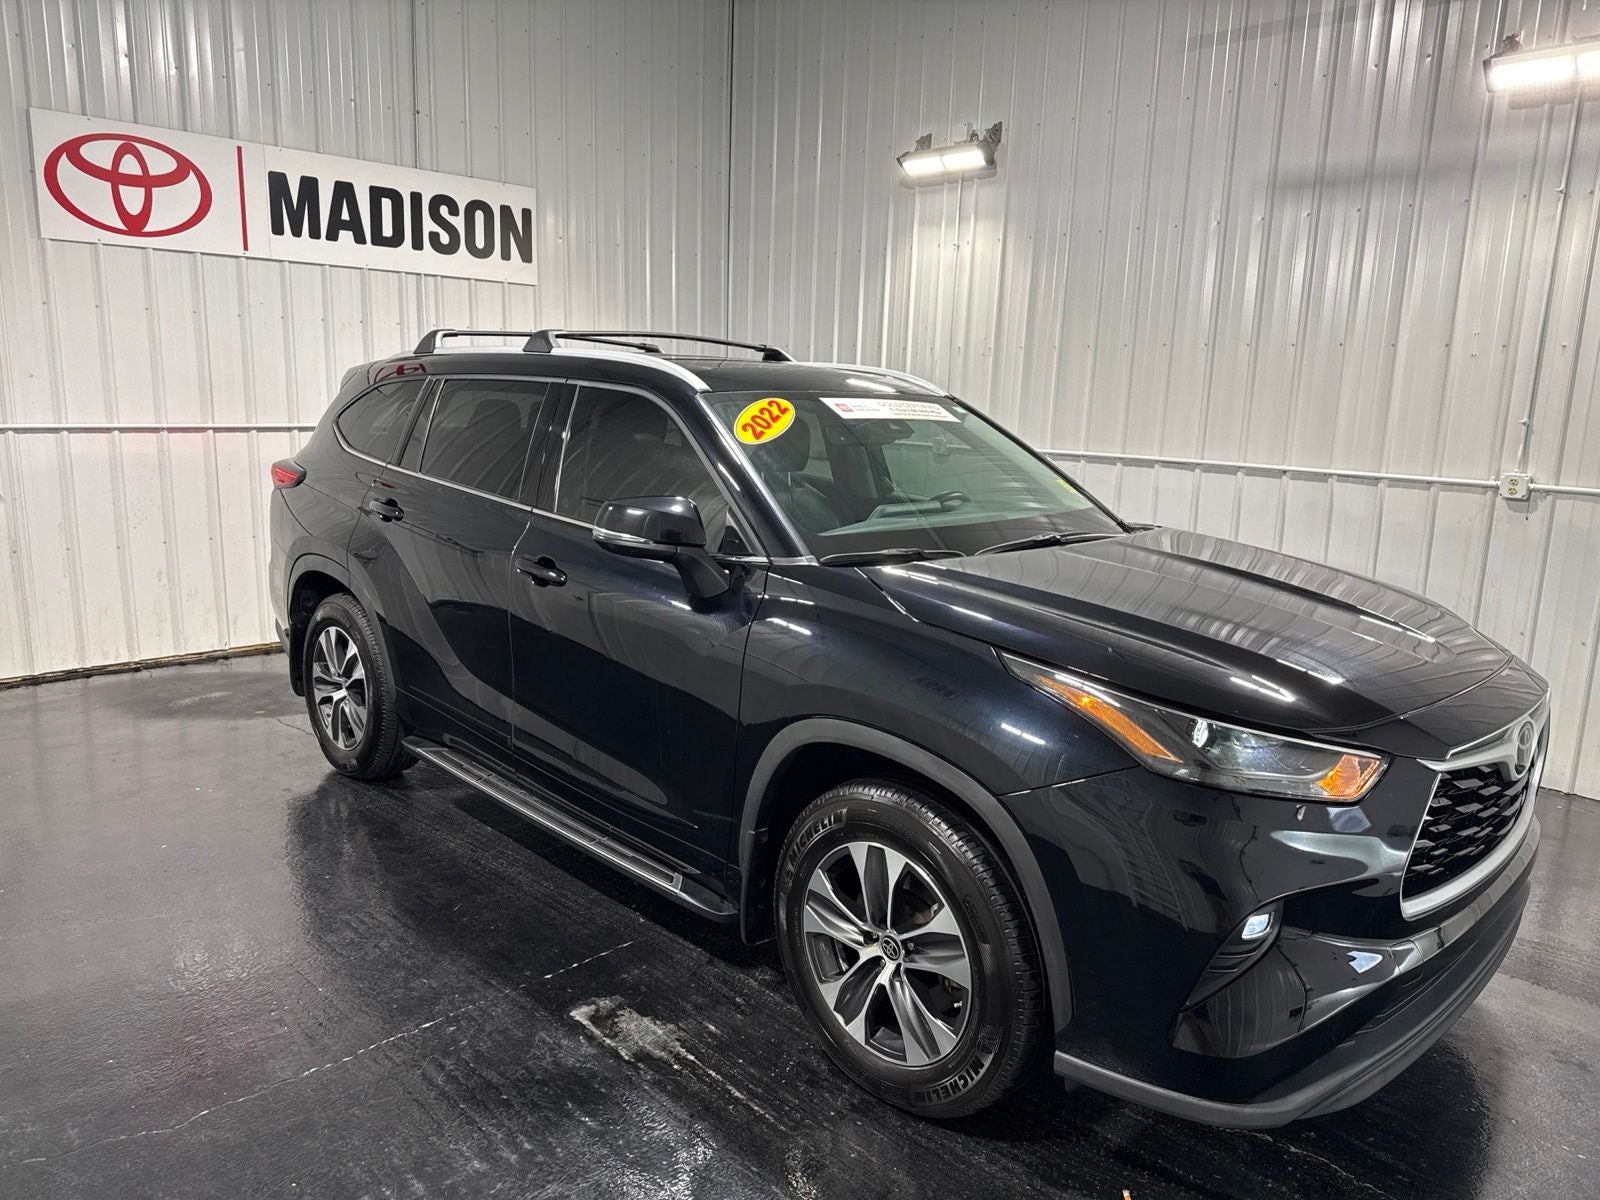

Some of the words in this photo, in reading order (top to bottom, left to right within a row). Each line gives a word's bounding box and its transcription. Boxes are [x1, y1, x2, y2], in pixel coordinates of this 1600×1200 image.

[268, 171, 532, 263] MADISON
[741, 399, 789, 440] 2022
[912, 1055, 986, 1103] MICHELIN
